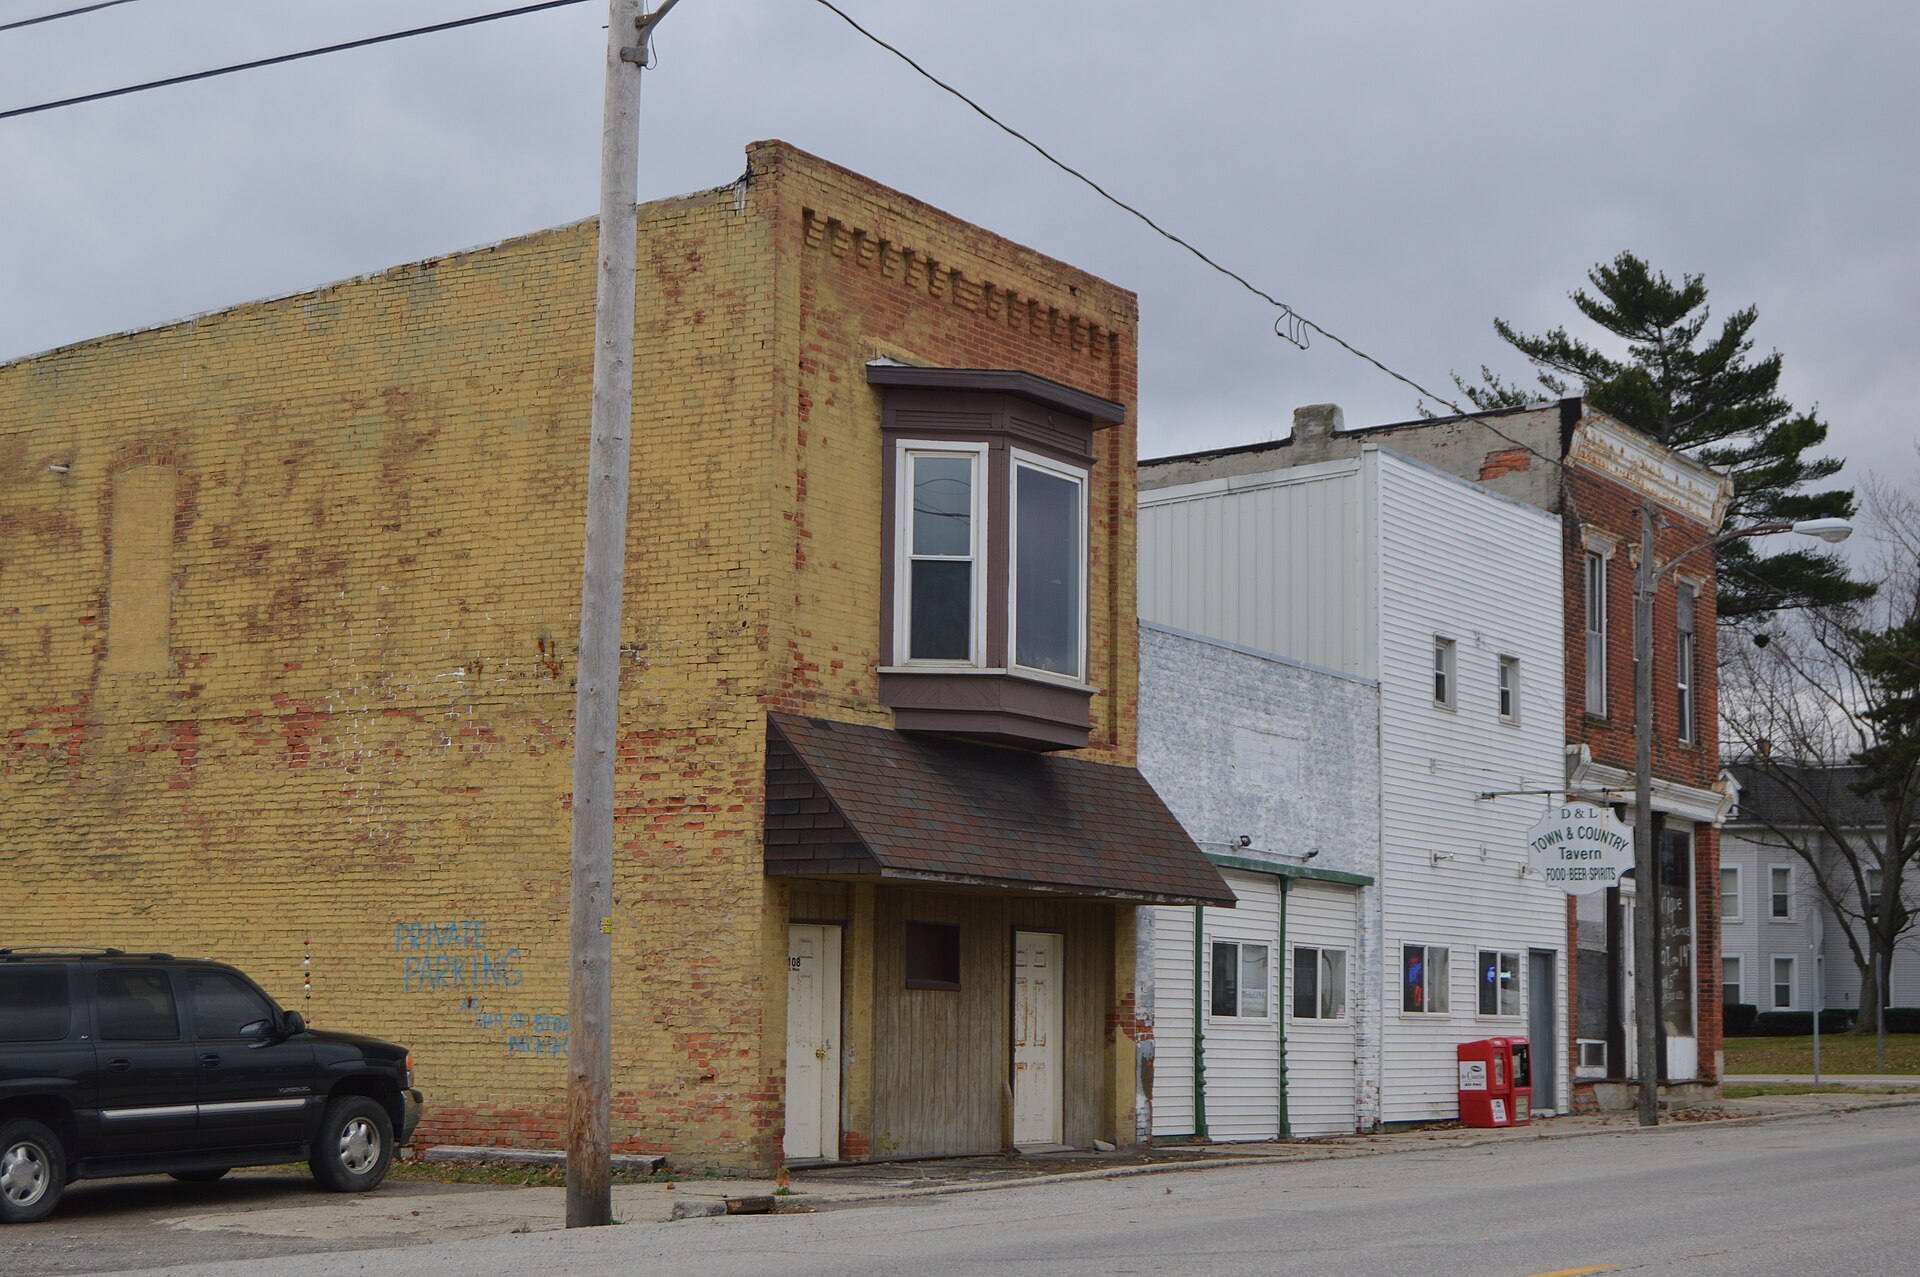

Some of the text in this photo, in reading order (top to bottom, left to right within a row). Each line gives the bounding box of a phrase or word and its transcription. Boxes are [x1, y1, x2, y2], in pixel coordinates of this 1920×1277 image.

[1561, 808, 1598, 819] D & L
[1531, 826, 1629, 853] TOWN & COUNTRY
[1558, 846, 1602, 860] Tavern
[395, 920, 487, 952] PRIVATE
[404, 948, 524, 993] PARKING
[788, 957, 801, 967] 108
